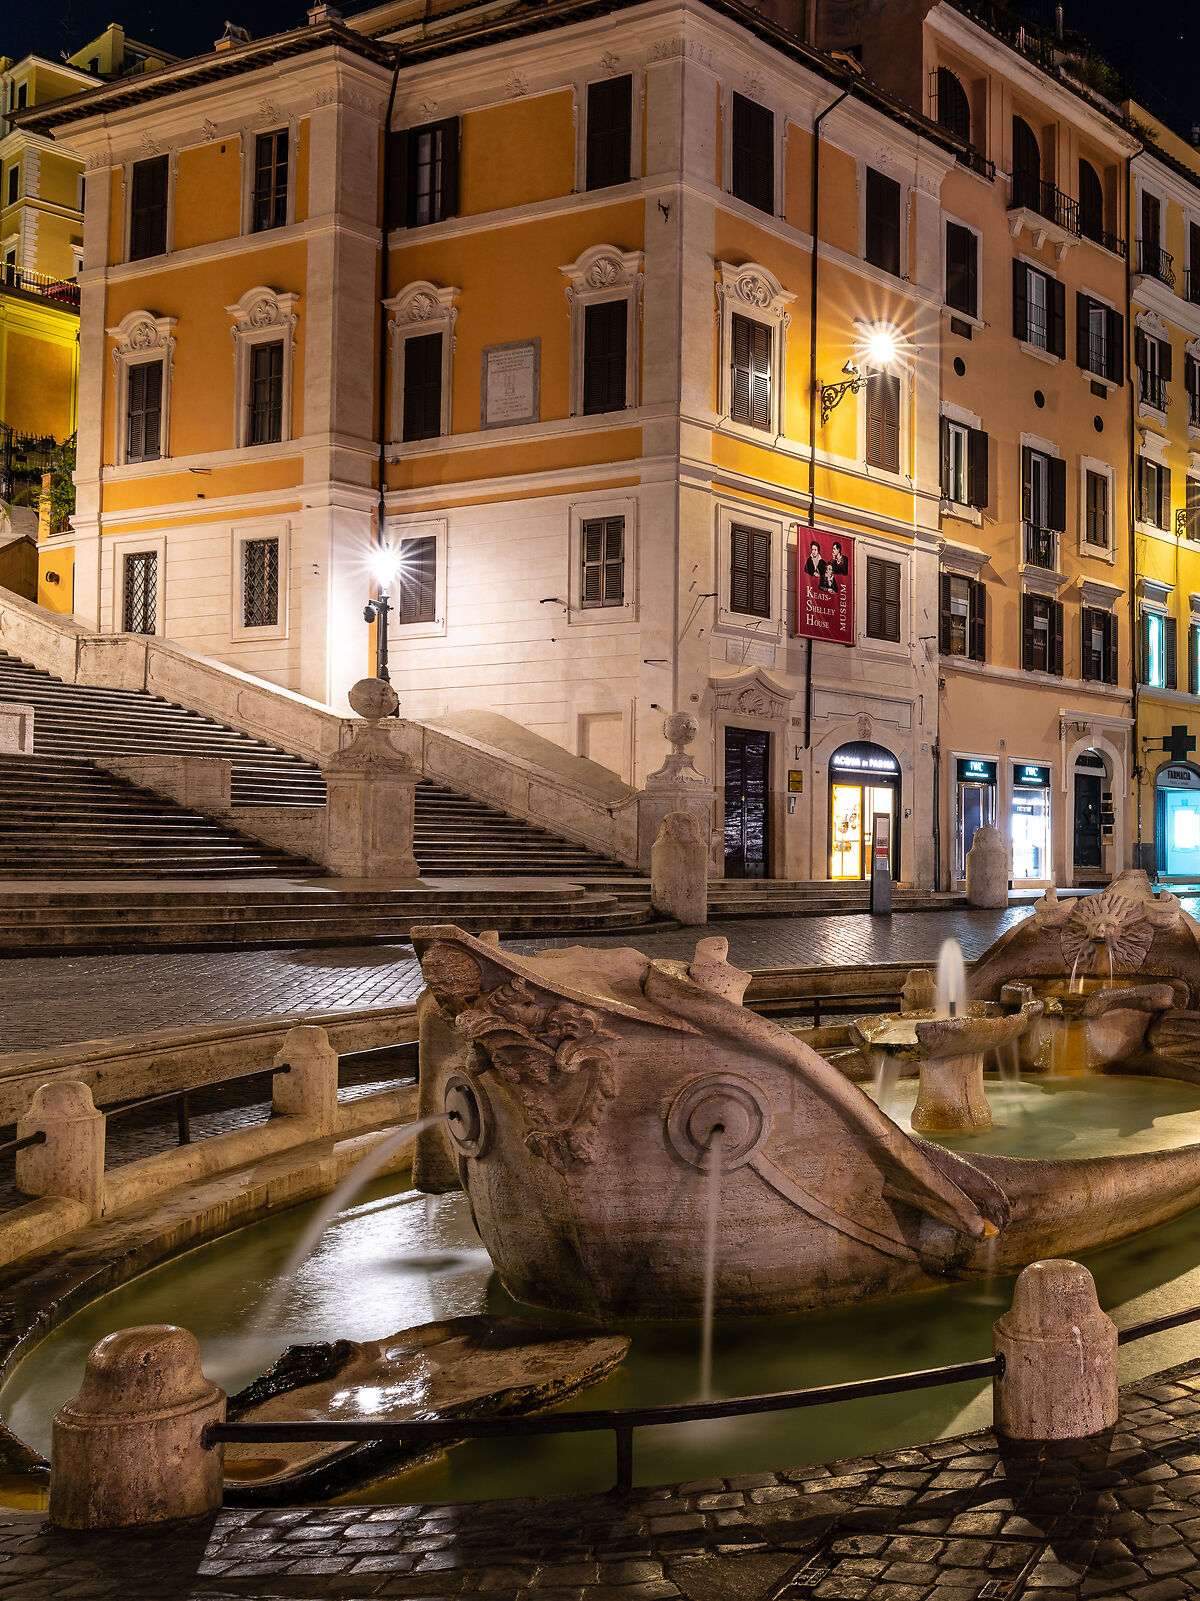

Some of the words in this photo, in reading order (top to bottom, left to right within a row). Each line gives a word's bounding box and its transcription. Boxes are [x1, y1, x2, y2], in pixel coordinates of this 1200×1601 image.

[806, 586, 832, 601] KEATS-
[806, 600, 836, 616] SHELLEY
[806, 614, 829, 629] HOUSE
[834, 755, 860, 767] ACQUA
[869, 758, 895, 769] PARMA
[1167, 770, 1191, 781] FARMACIA
